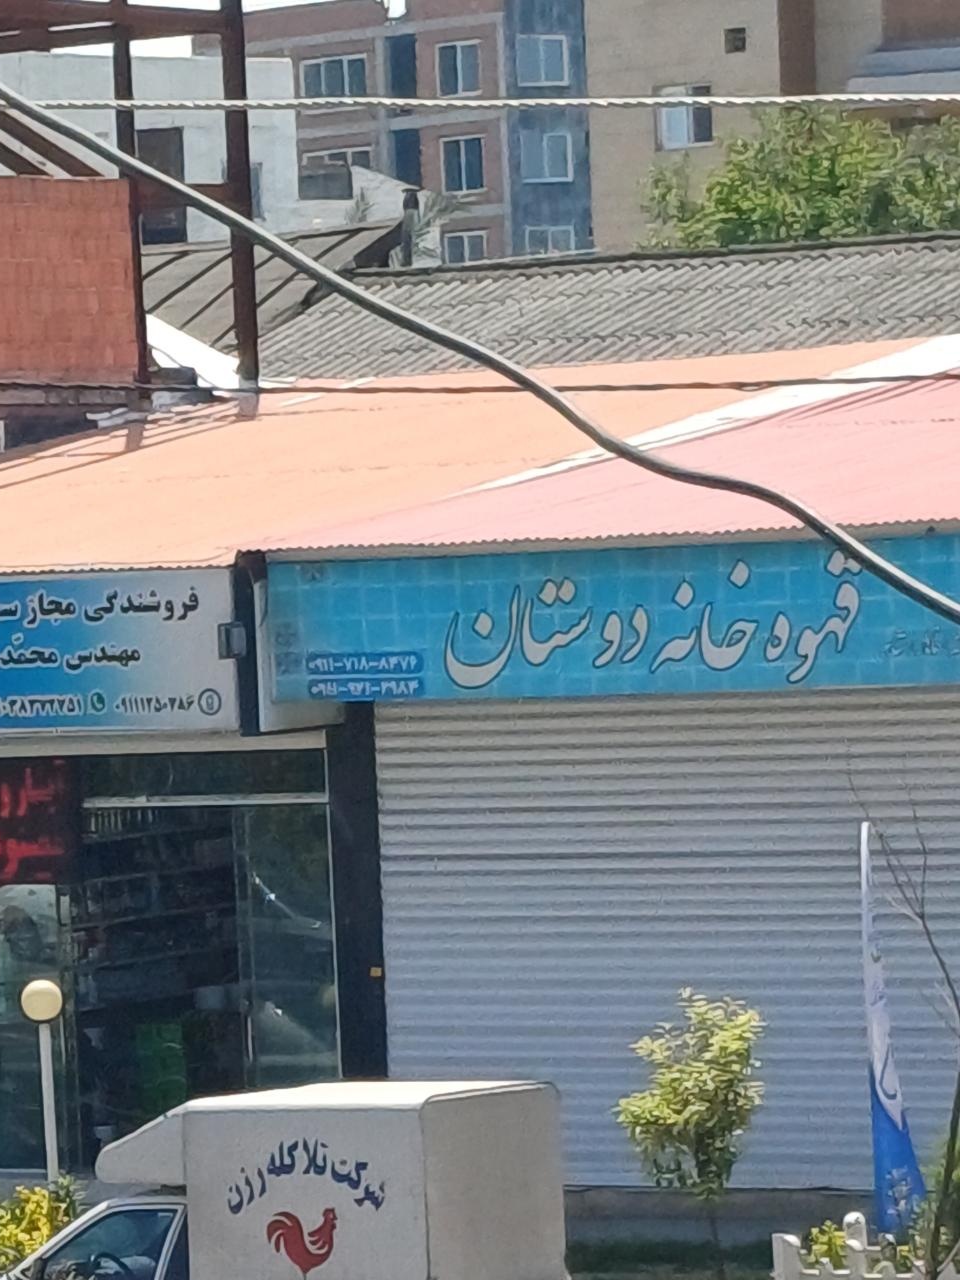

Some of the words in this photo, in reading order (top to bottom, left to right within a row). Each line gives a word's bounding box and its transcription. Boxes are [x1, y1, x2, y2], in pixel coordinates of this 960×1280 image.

[23, 593, 77, 627] مجاز
[83, 587, 200, 623] فروشندگی
[444, 577, 650, 690] دوستان
[649, 559, 760, 674] خانه
[764, 550, 863, 684] قهوه
[64, 642, 142, 673] مهندس
